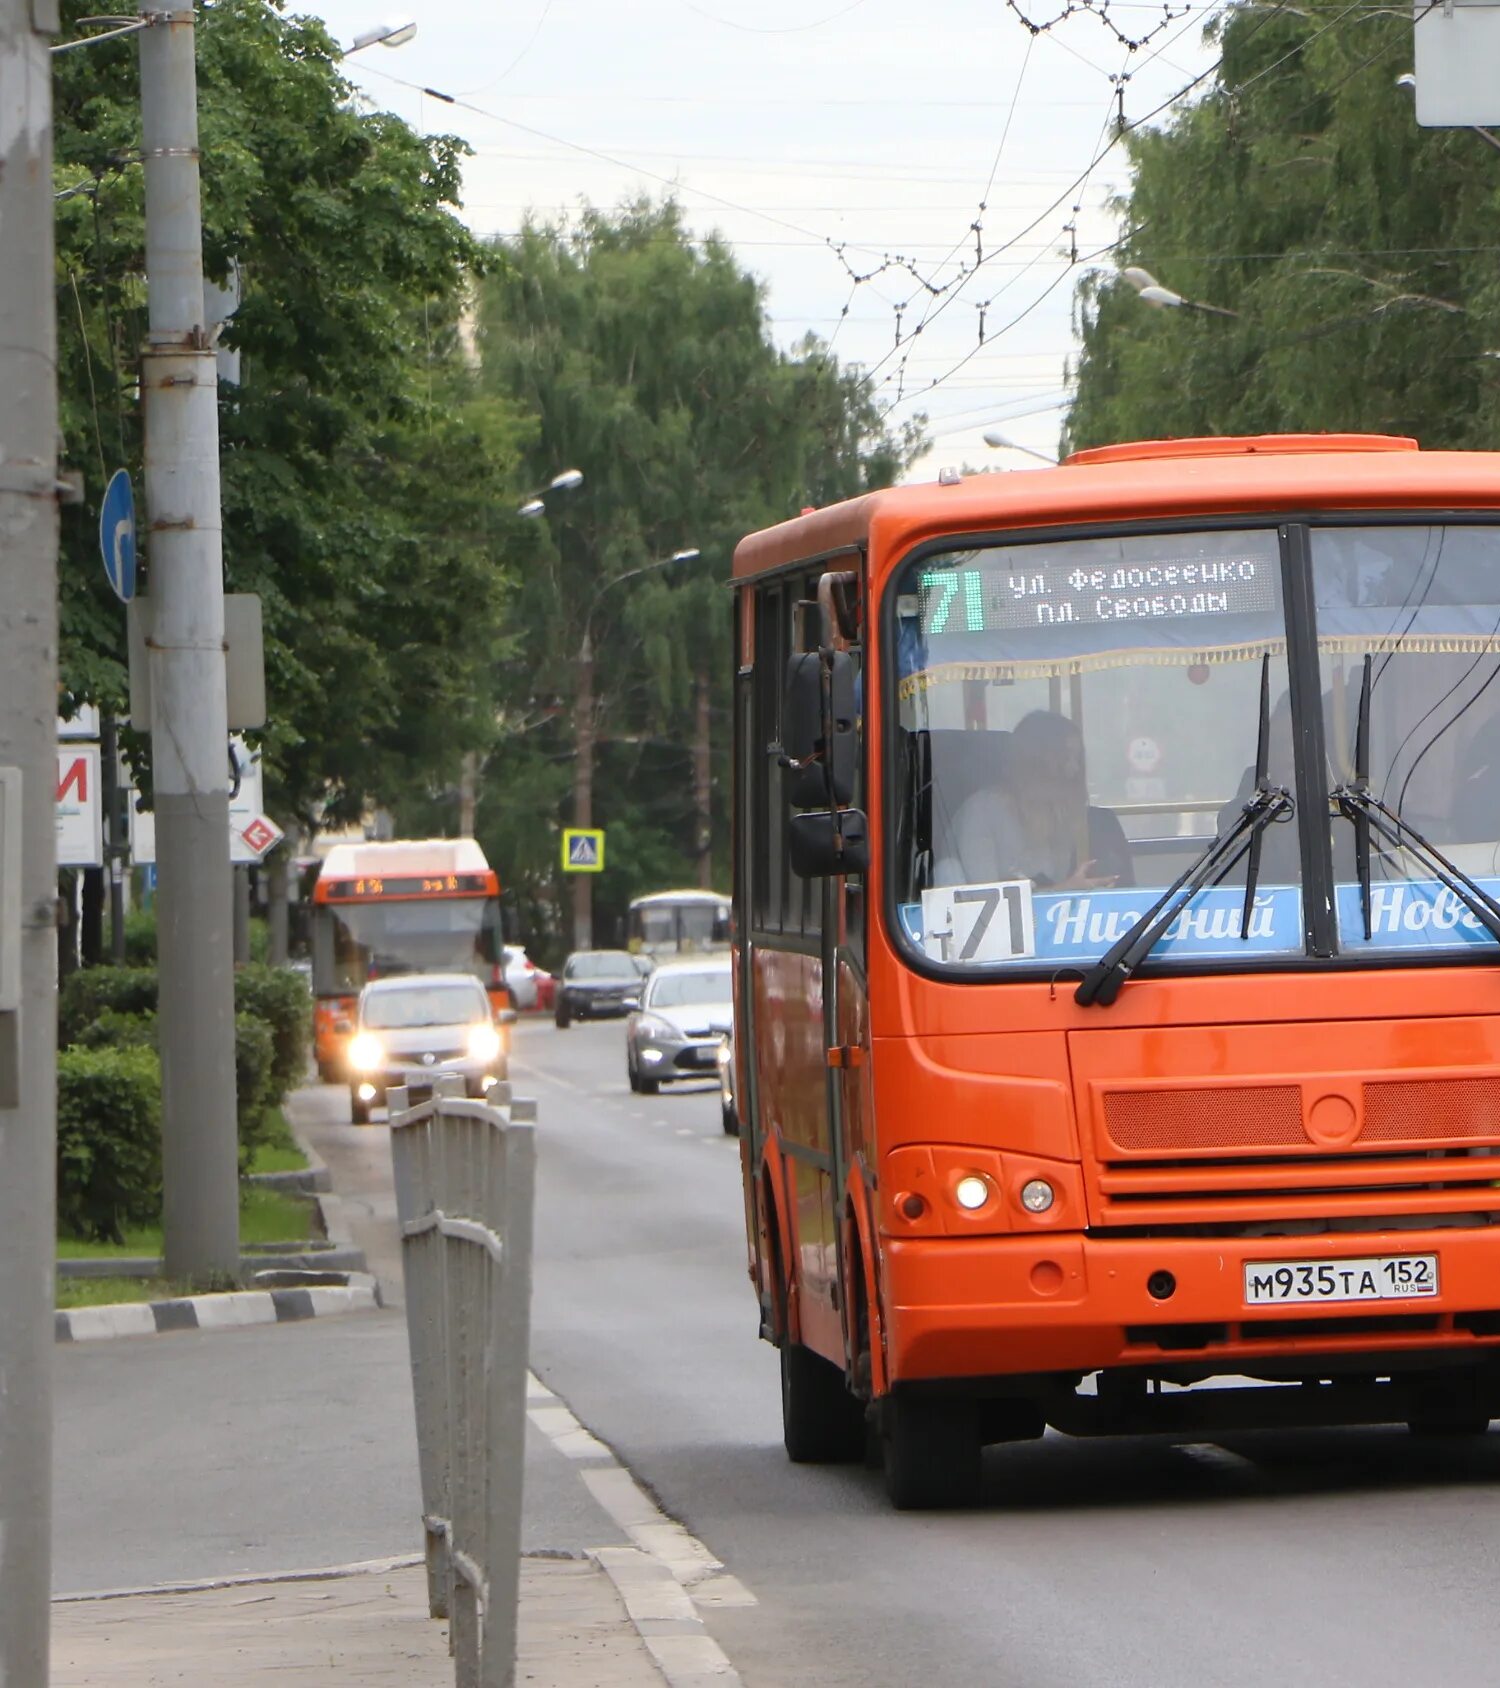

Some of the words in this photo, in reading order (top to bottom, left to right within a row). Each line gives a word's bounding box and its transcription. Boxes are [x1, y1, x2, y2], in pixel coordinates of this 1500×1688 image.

[922, 571, 983, 634] 71
[1008, 576, 1052, 599] ул.
[1036, 603, 1080, 625] пл.
[1096, 592, 1229, 619] Свободы
[954, 886, 1025, 959] 71
[1253, 1266, 1376, 1298] М935ТА
[1383, 1260, 1429, 1284] 152
[1394, 1283, 1416, 1293] RUS
